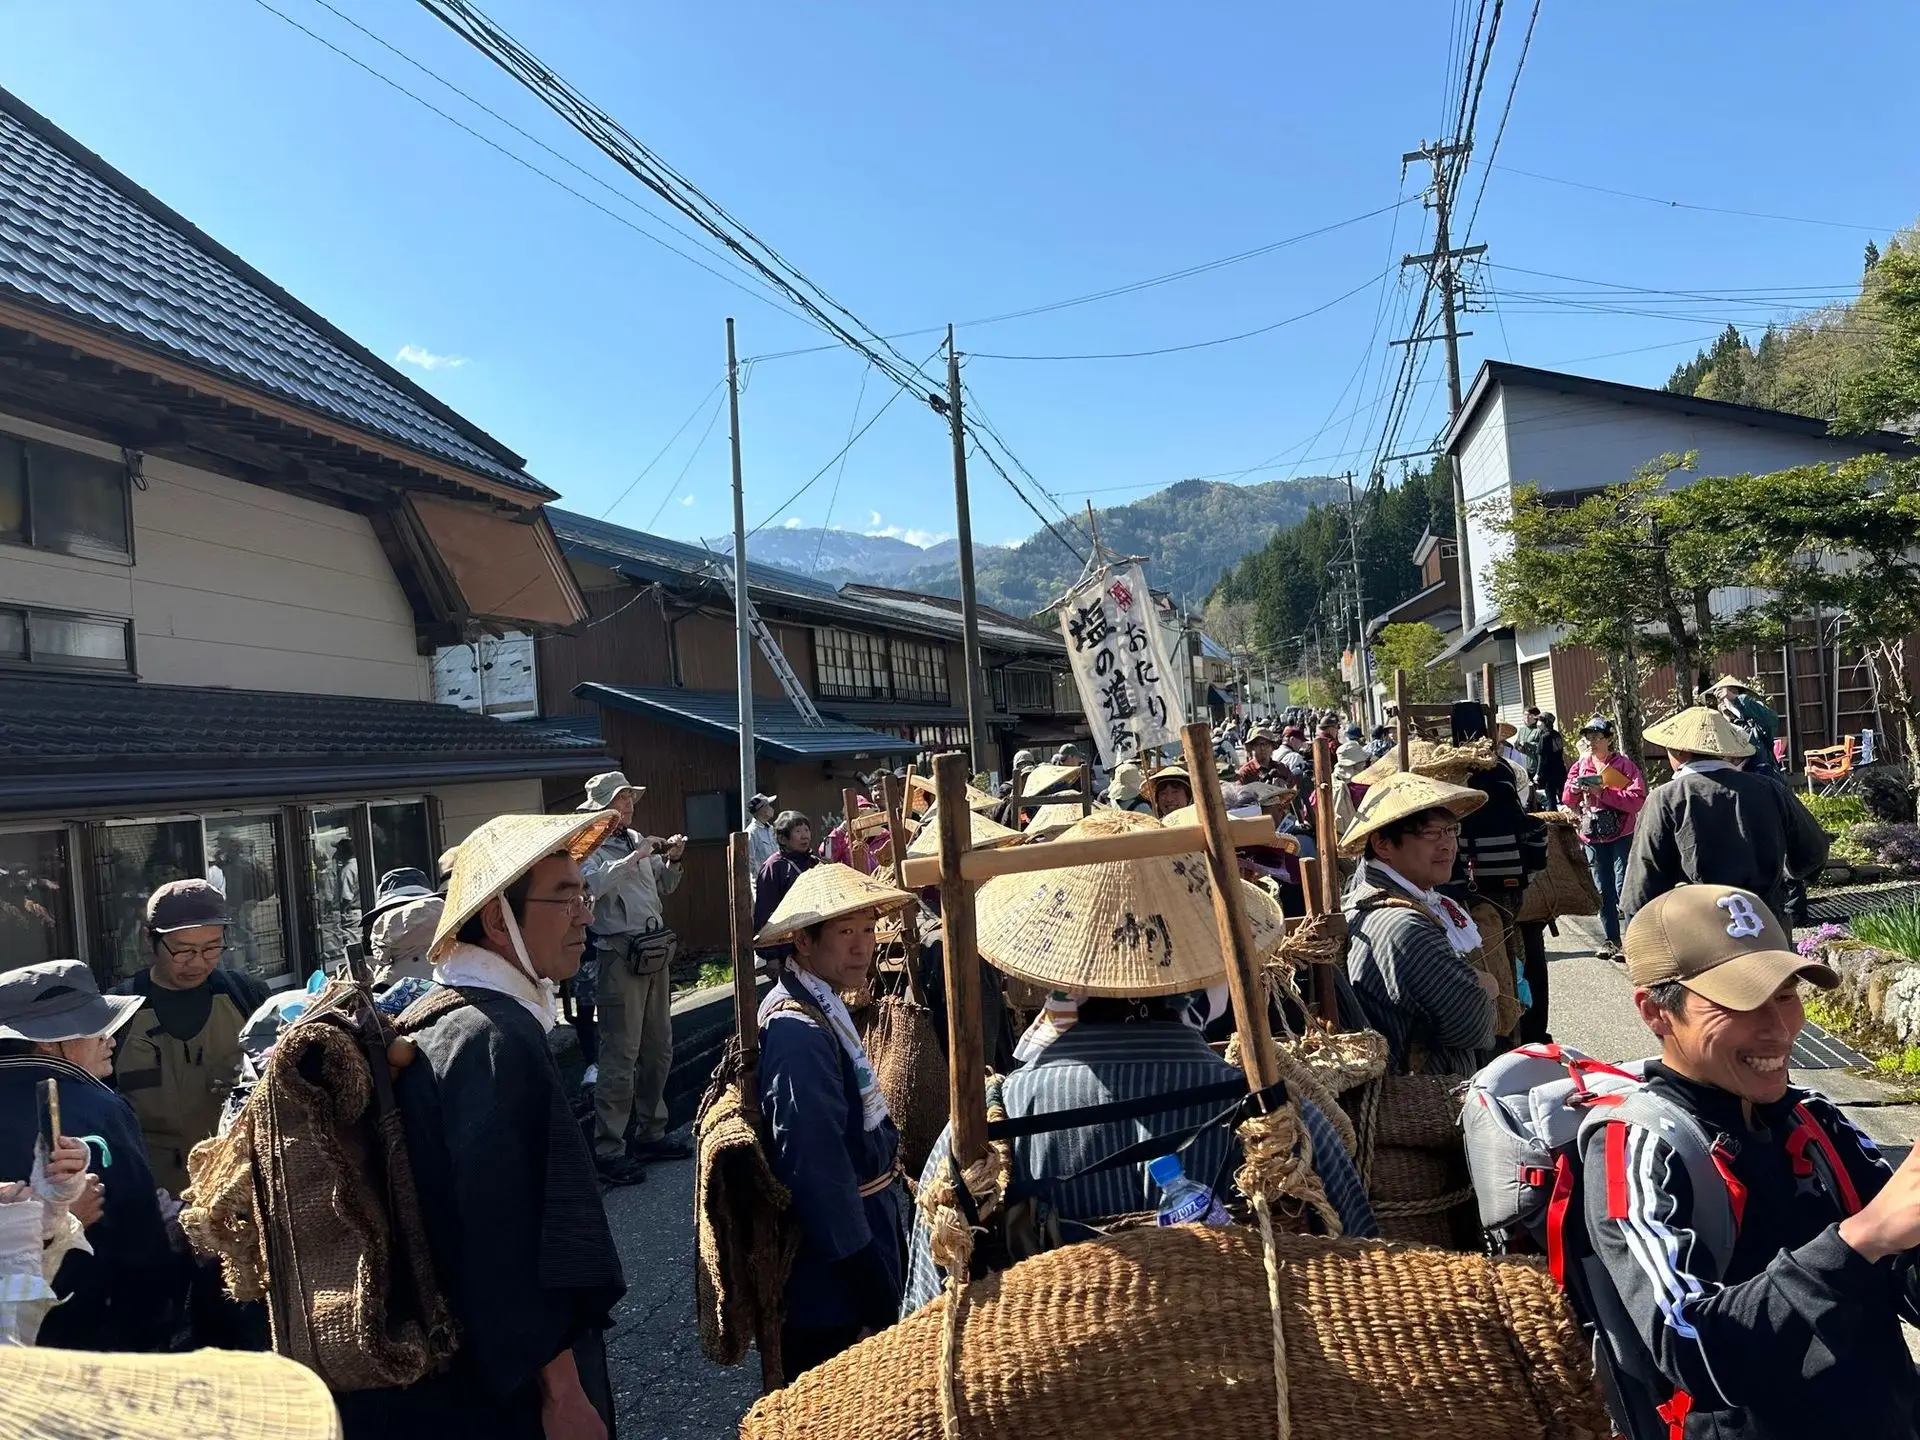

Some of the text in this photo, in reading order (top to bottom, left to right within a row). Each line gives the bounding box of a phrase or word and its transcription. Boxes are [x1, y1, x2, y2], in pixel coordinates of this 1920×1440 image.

[1124, 622, 1167, 728] おたり
[1716, 893, 1765, 939] B
